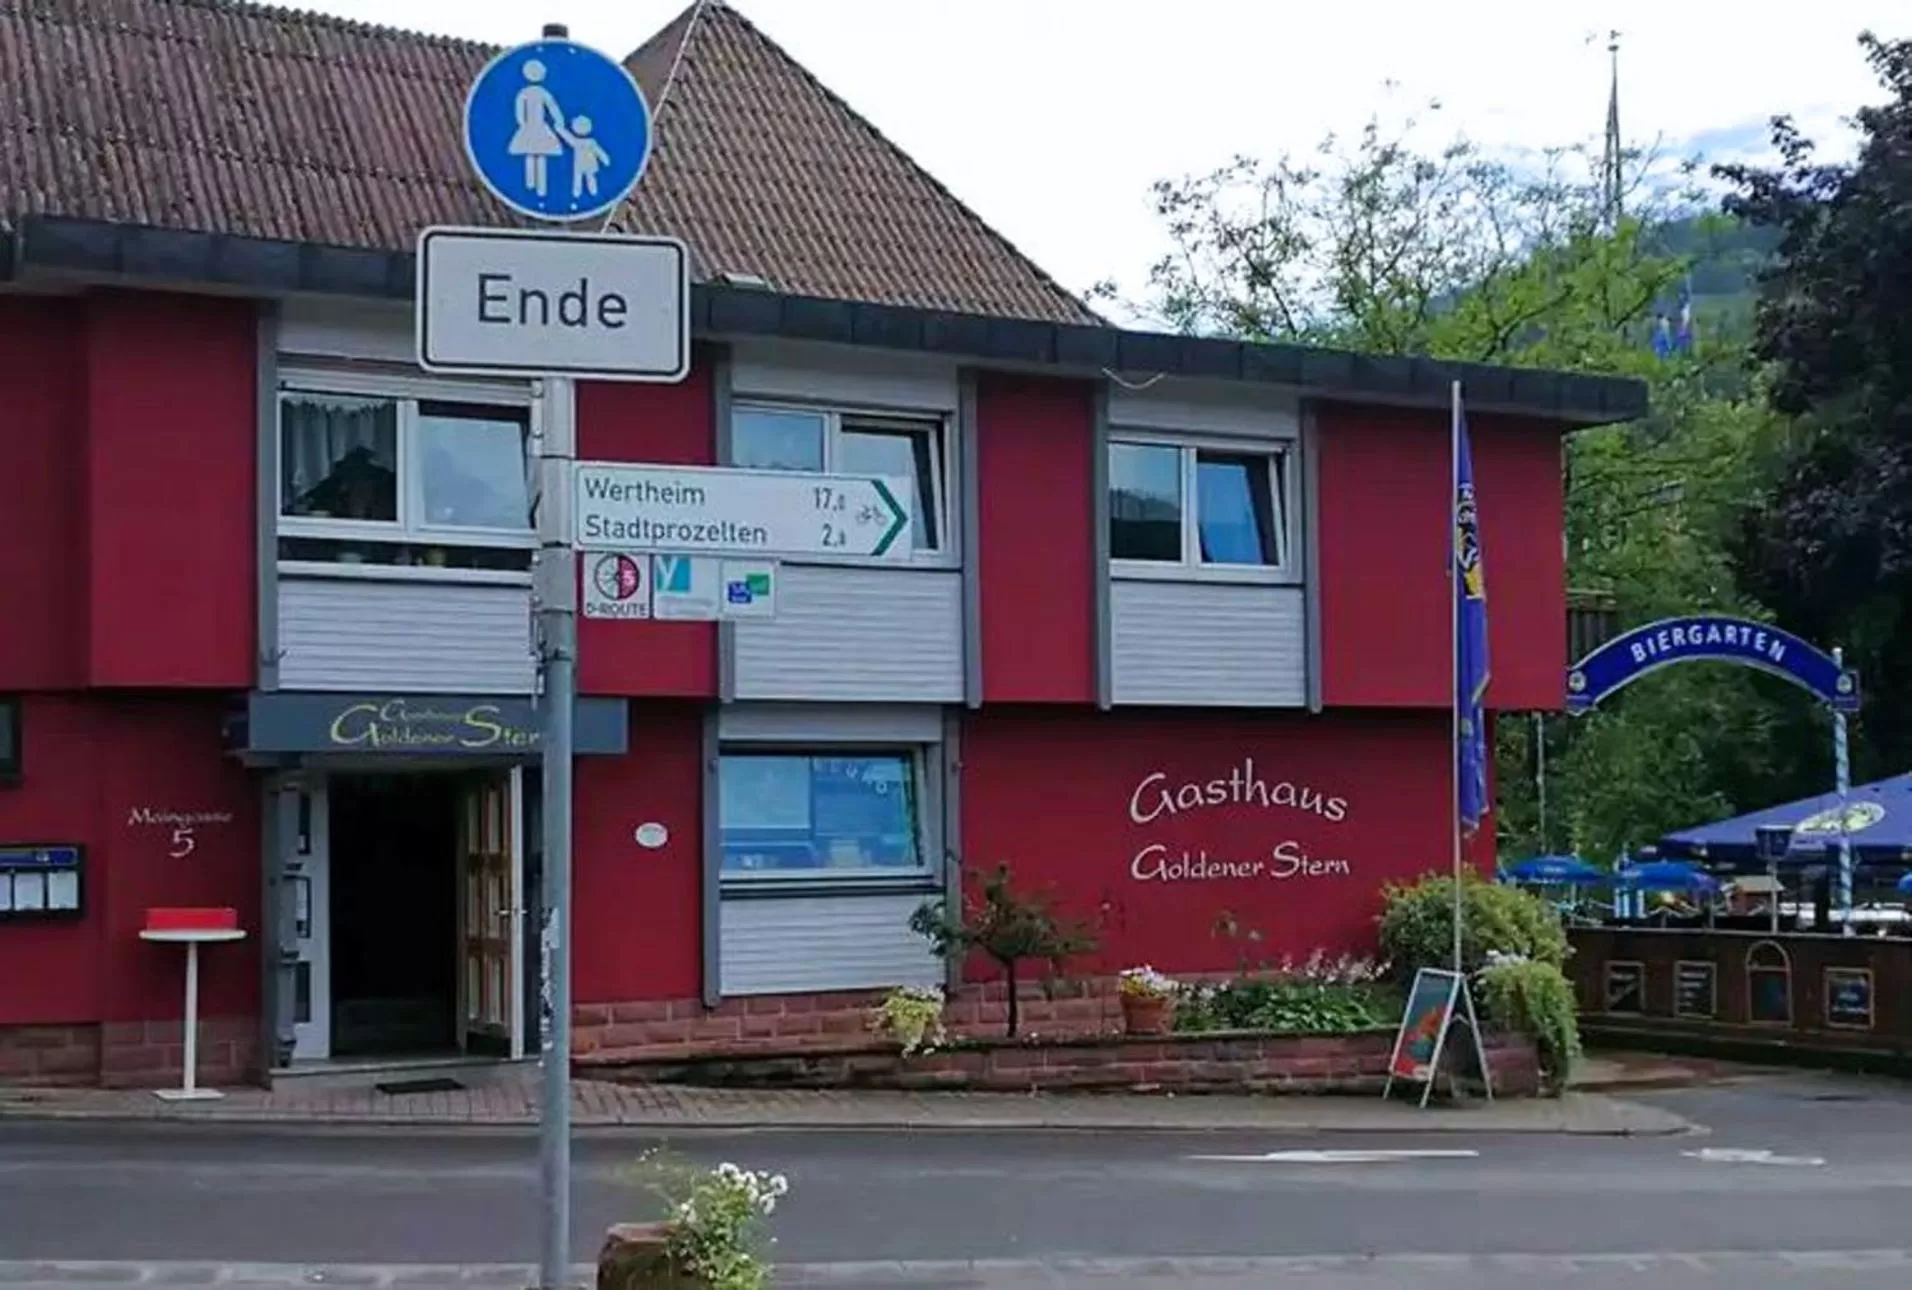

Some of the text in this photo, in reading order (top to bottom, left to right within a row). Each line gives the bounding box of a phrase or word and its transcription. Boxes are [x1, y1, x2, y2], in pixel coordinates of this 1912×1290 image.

[478, 273, 628, 329] Ende
[585, 476, 706, 506] Wertheim
[585, 513, 768, 547] Stadtprozelten
[586, 602, 648, 617] D-ROUTE
[1630, 623, 1787, 663] BIERGARTEN
[460, 705, 541, 747] Ster
[1130, 757, 1348, 824] Gasthaus
[168, 827, 195, 858] 5
[1131, 840, 1350, 882] Goldener Stern
